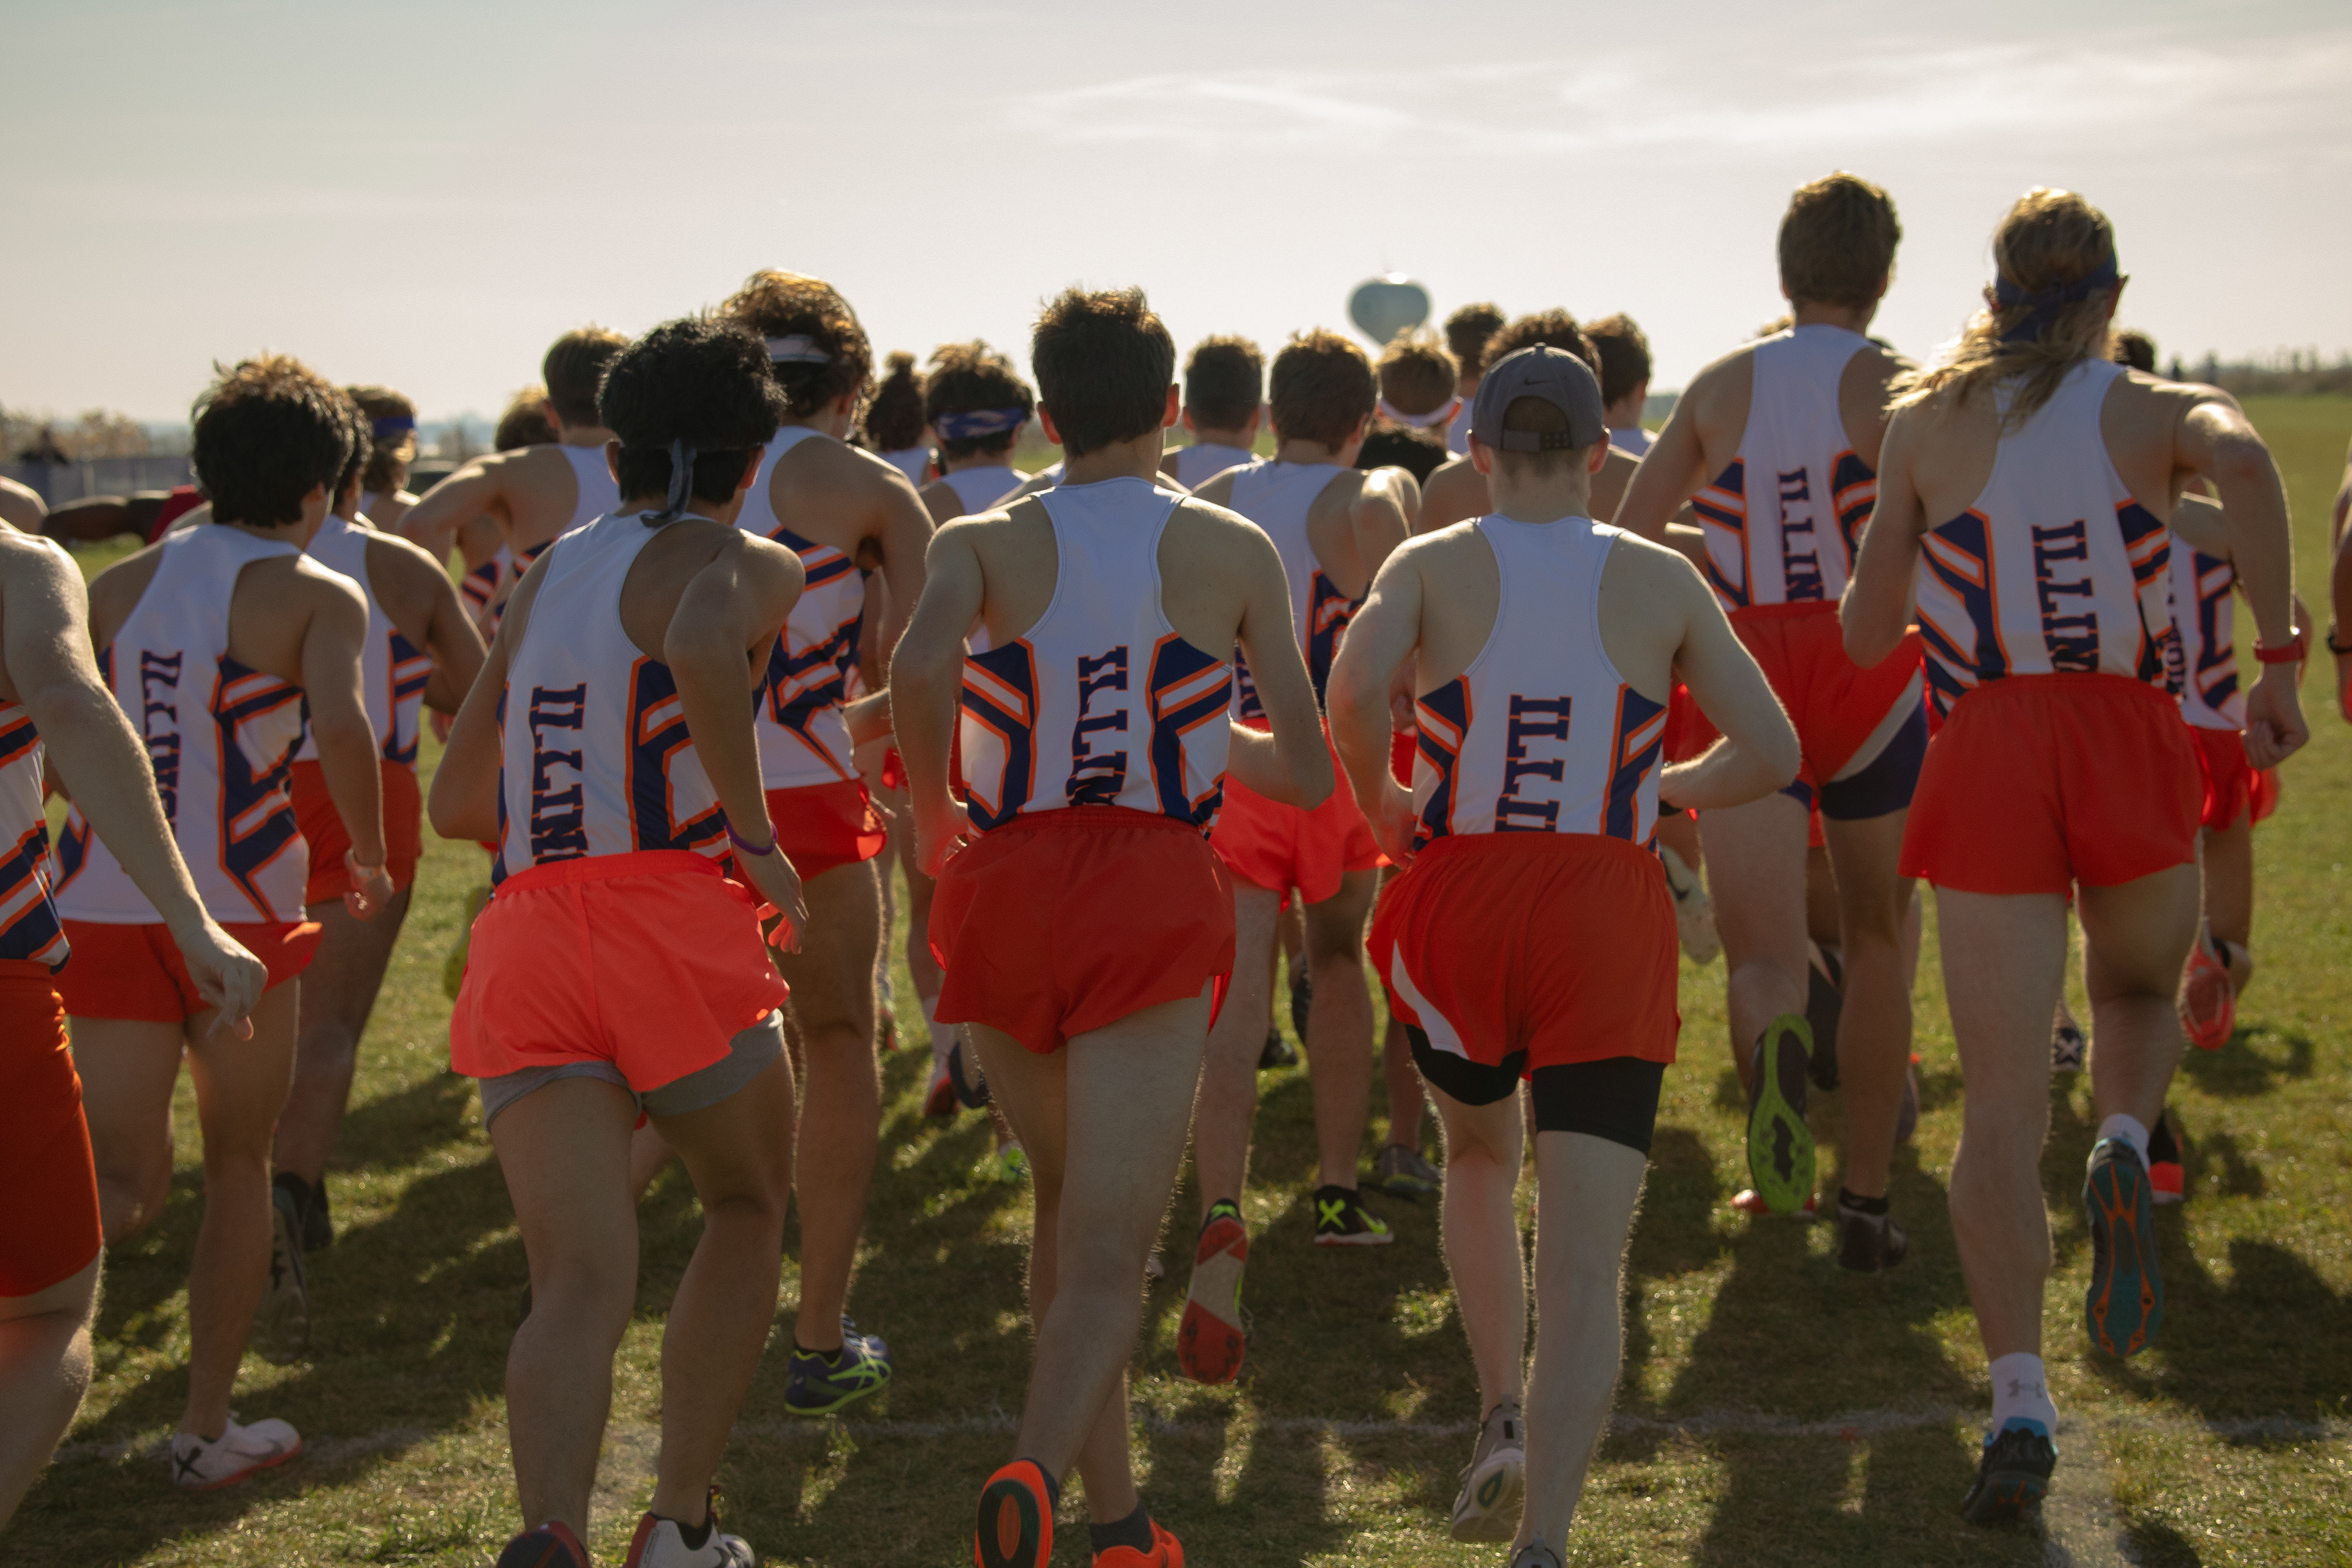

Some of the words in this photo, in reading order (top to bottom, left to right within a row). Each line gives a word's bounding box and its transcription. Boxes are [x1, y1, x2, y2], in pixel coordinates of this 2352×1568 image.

[2030, 519, 2099, 673] ILLIN
[140, 648, 184, 842] ILLIN
[529, 682, 589, 865] ILLIN
[1493, 693, 1572, 832] ILLI
